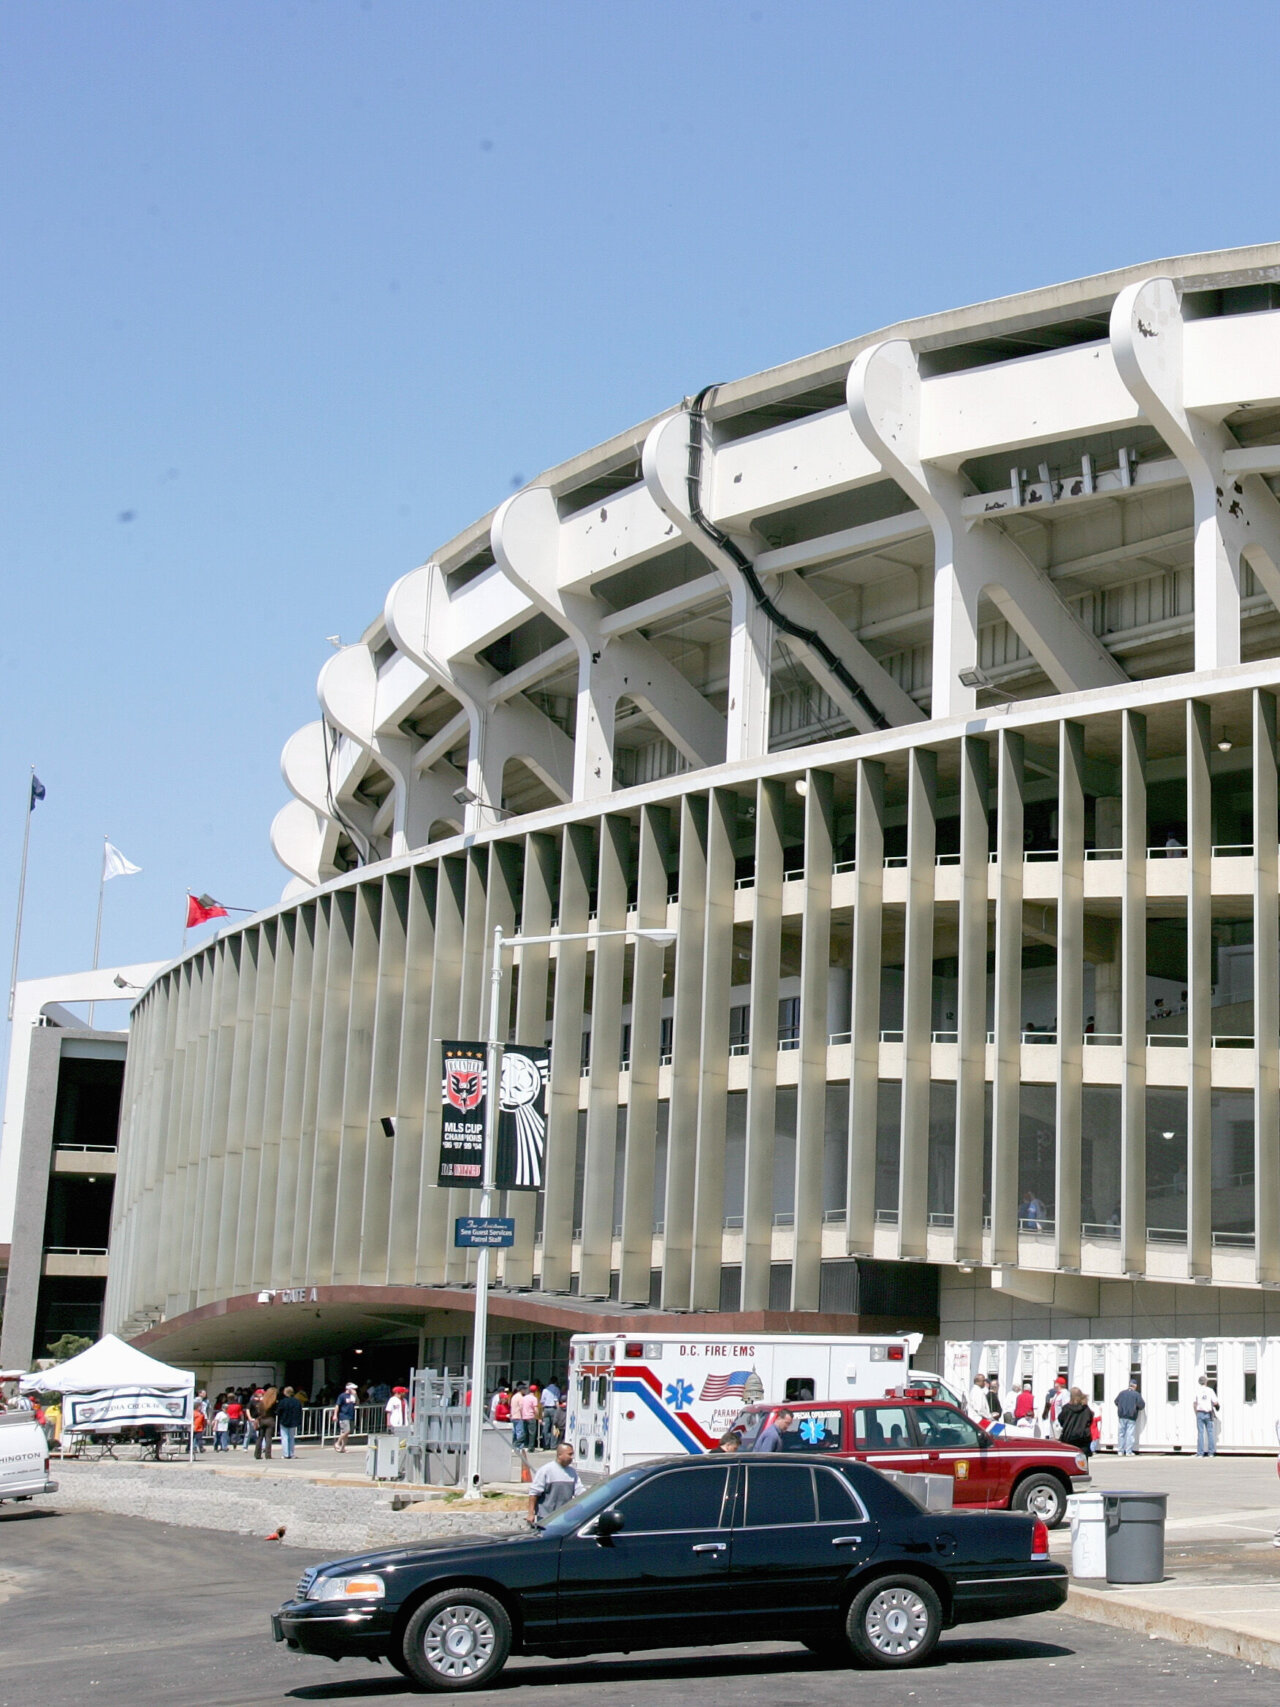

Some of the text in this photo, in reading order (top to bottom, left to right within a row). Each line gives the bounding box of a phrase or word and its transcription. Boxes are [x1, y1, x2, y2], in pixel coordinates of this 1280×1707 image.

[444, 1122, 482, 1134] MLS CUP
[489, 1229, 513, 1237] Services
[309, 1287, 318, 1302] A
[680, 1345, 756, 1357] D.C. FIRE/EMS
